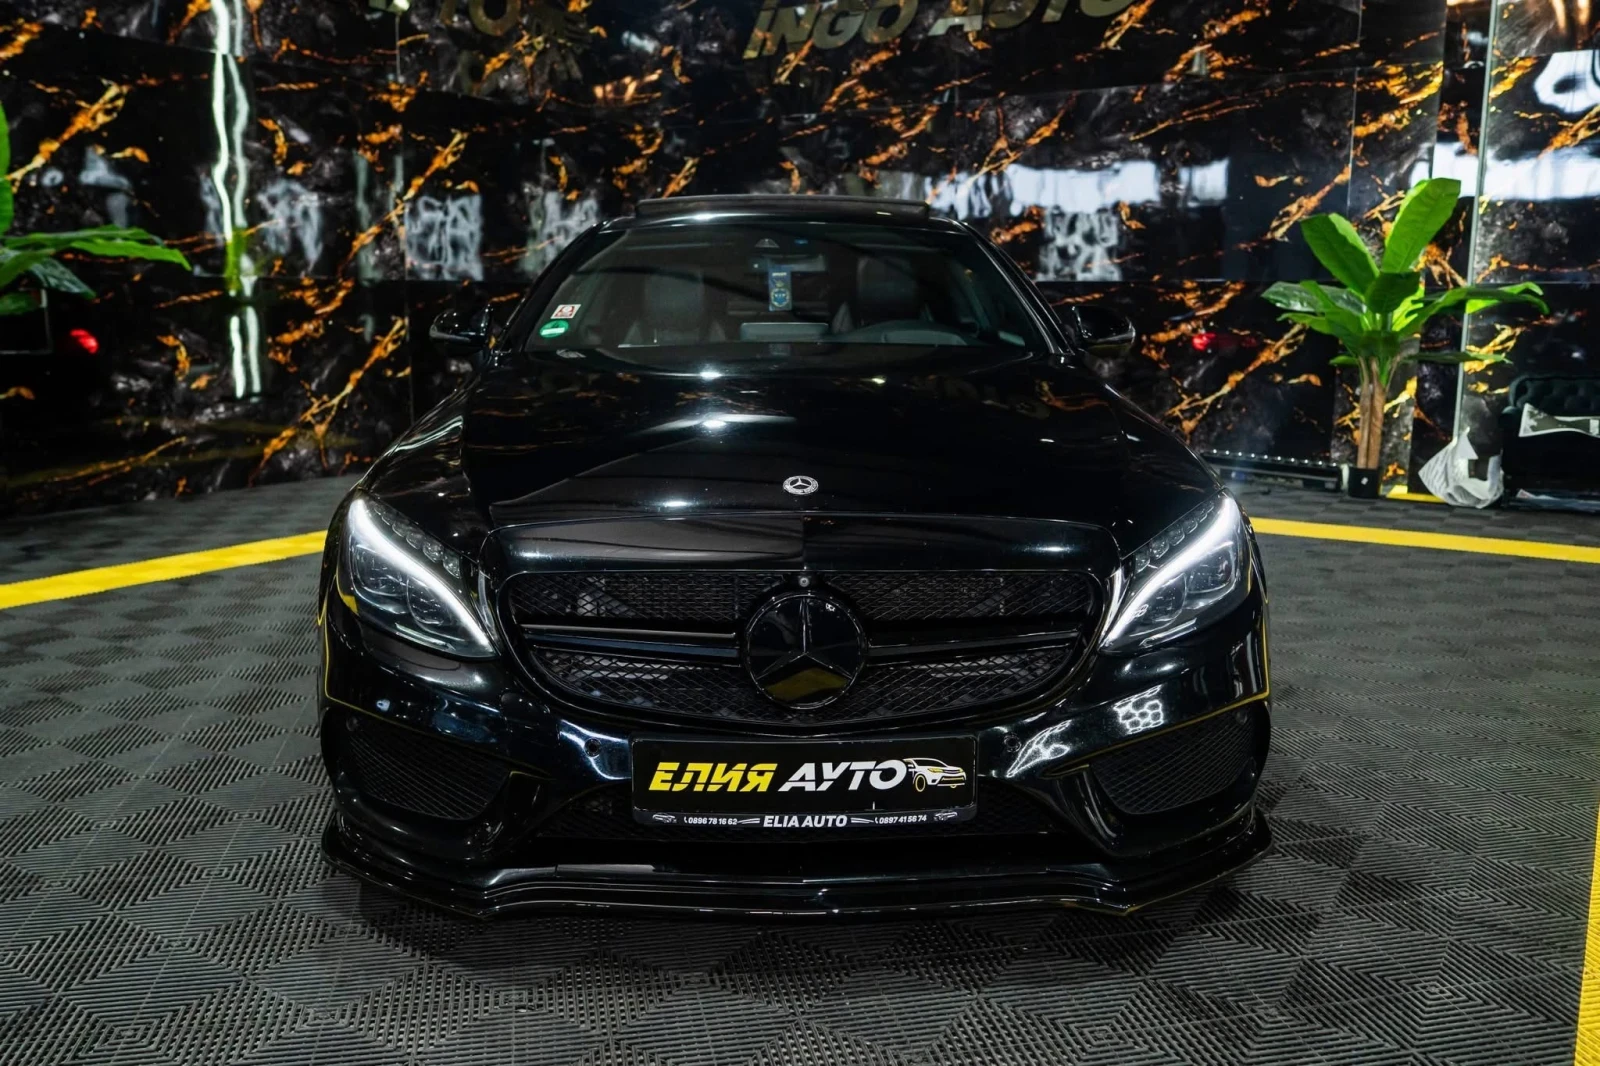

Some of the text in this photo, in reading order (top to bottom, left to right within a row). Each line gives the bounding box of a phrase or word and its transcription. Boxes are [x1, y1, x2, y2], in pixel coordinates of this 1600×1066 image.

[648, 759, 907, 792] ЕЛИЯ АУТО
[763, 815, 800, 828] ELIA
[800, 815, 848, 828] AUTO
